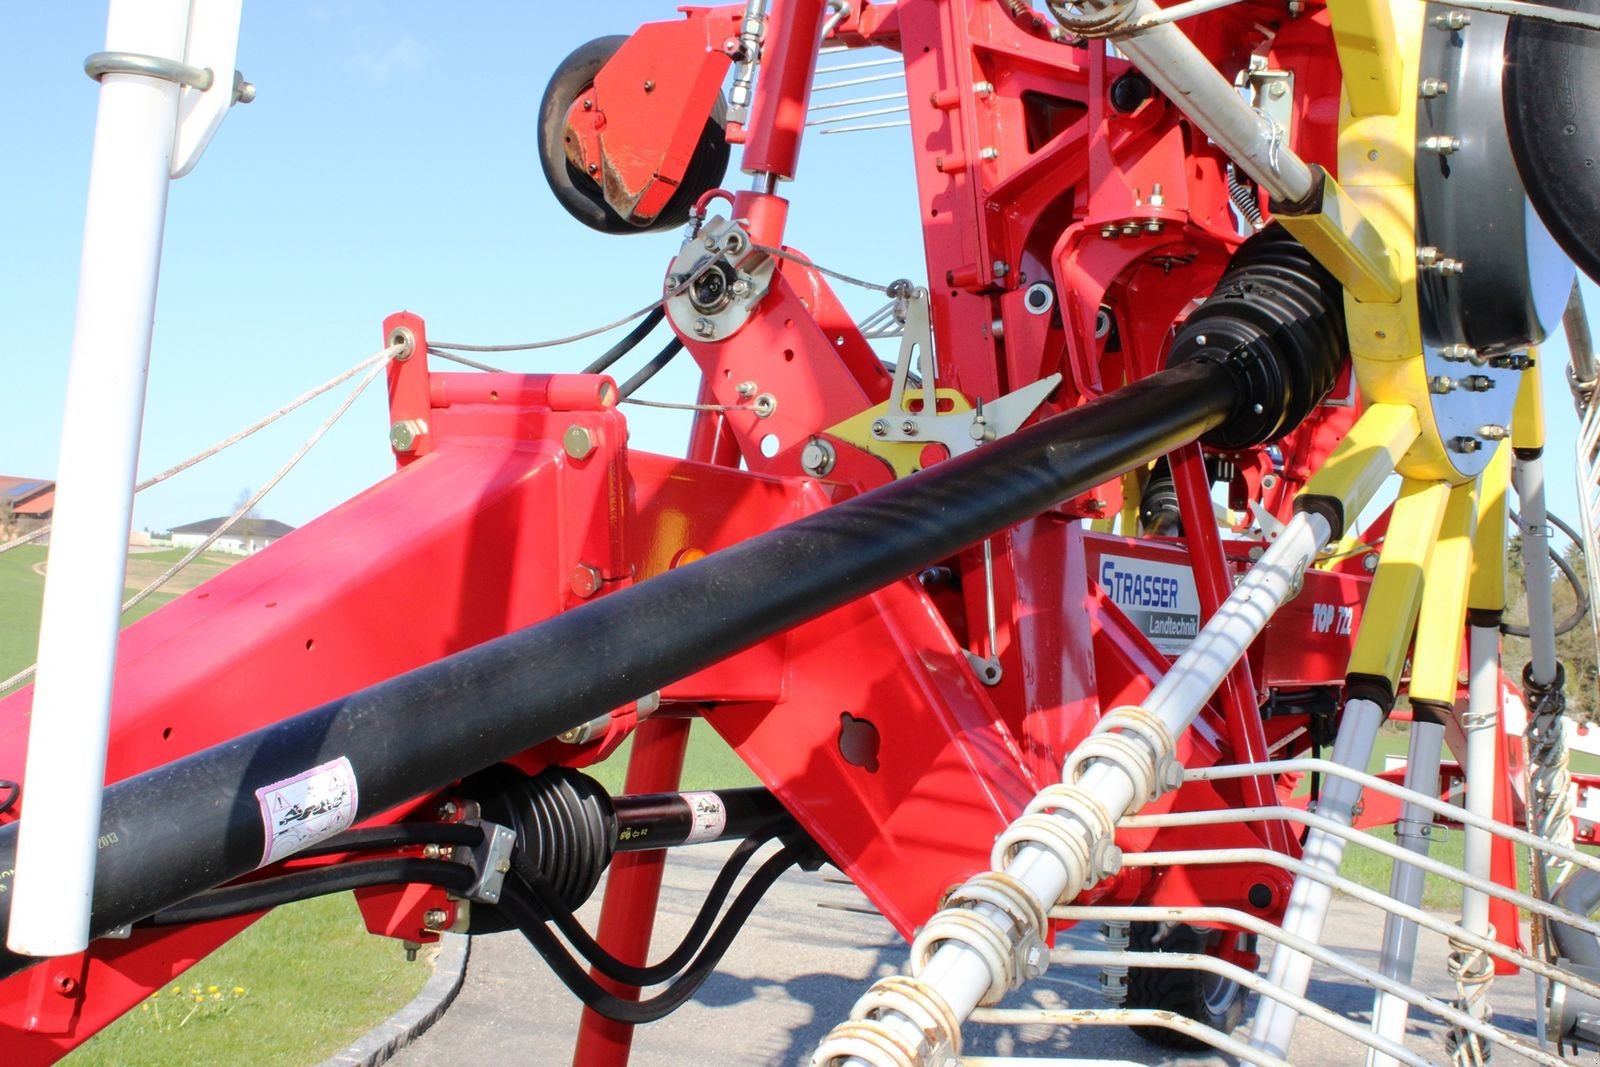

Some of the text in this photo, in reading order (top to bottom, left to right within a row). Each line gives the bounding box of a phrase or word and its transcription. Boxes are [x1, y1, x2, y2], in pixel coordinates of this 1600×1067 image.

[1102, 561, 1178, 609] STRASSER
[1149, 615, 1196, 635] Landtechnik
[1312, 603, 1335, 633] TOP
[97, 832, 119, 849] 2013
